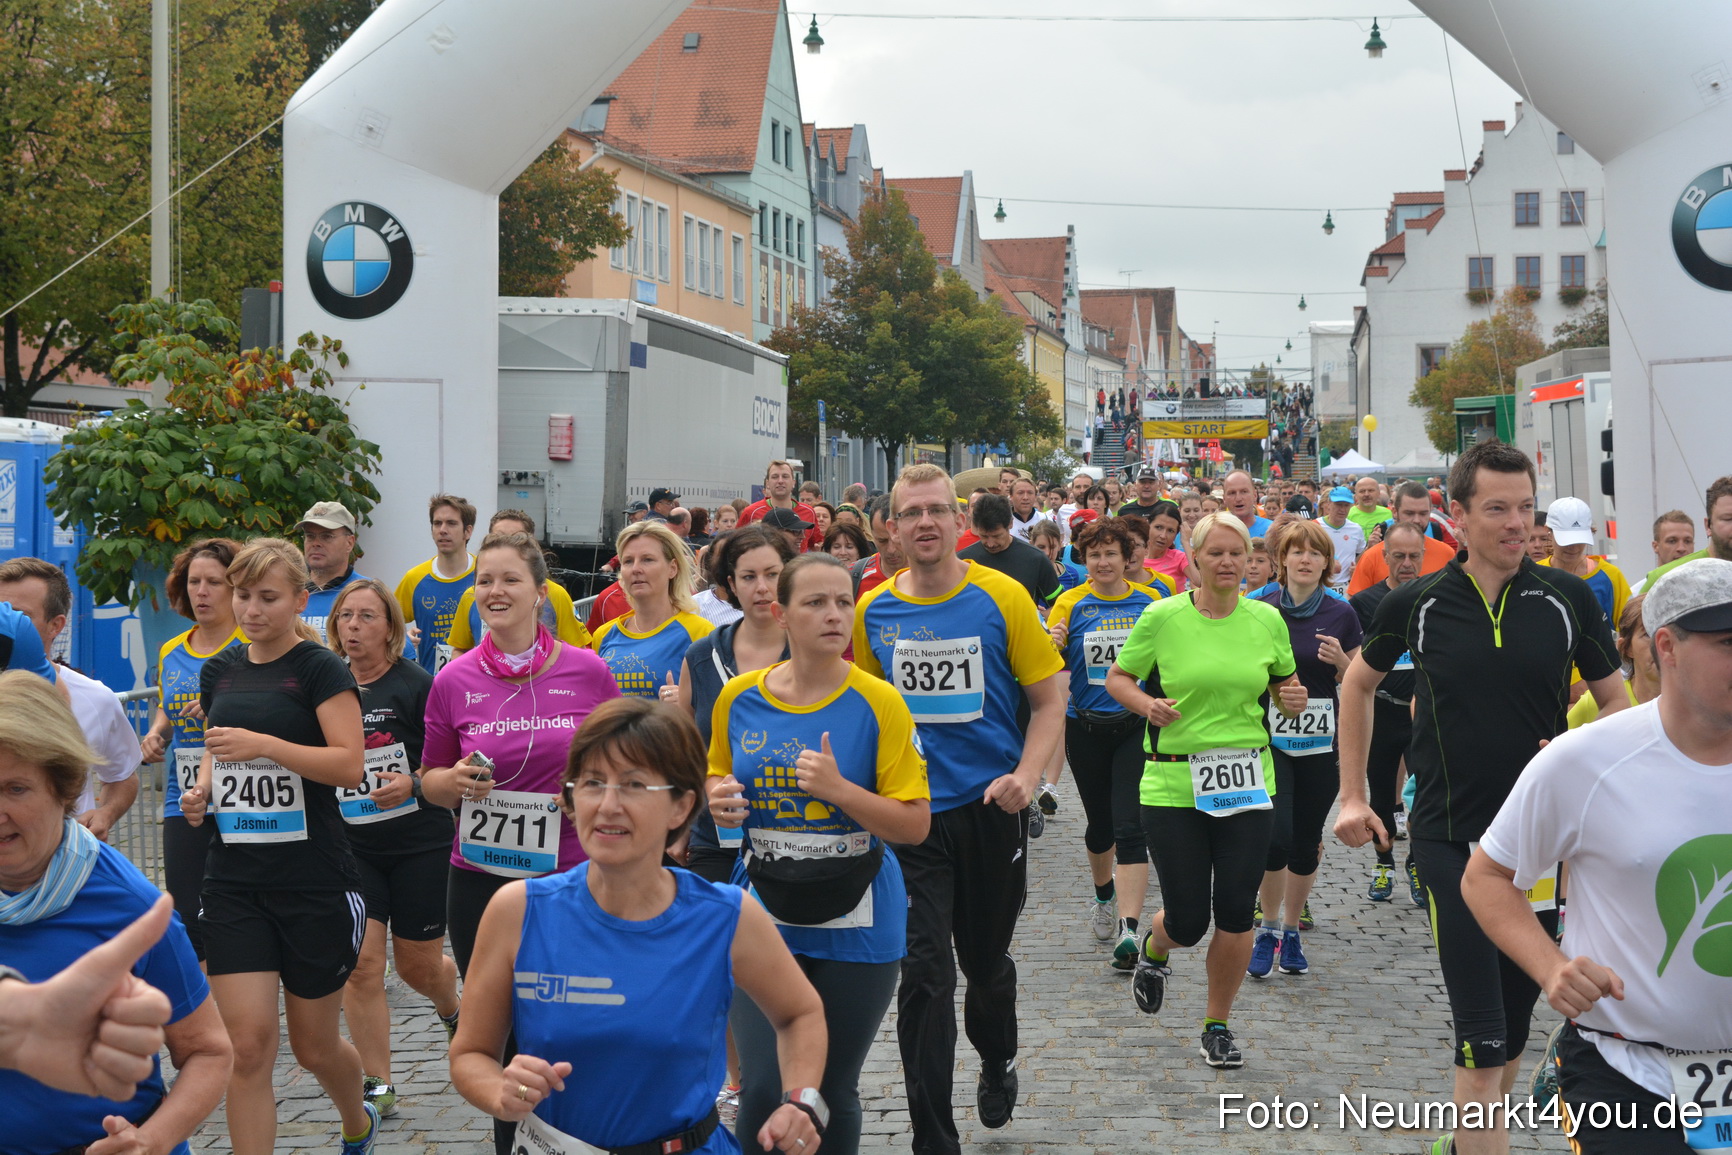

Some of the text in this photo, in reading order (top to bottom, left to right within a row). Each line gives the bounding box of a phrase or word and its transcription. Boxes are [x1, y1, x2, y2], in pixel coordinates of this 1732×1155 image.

[314, 204, 405, 243] BMW
[752, 396, 781, 439] BOCK
[1183, 424, 1227, 435] START
[895, 647, 965, 657] PARTL Neumarkt
[901, 659, 972, 692] 3321
[468, 715, 575, 736] Energiebündel
[1275, 713, 1329, 734] 2424
[1287, 740, 1314, 749] Teresa
[365, 754, 392, 764] umarkt
[1190, 752, 1249, 765] PARTL Neumarkt
[214, 762, 283, 771] PARTL Neumarkt
[1199, 761, 1256, 792] 2601
[220, 775, 295, 808] 2405
[496, 799, 543, 811] Neumarkt
[1213, 795, 1253, 808] Susanne
[234, 817, 278, 830] Jasmin
[470, 809, 547, 849] 2711
[752, 838, 833, 853] PARTL Neumarkt
[484, 850, 531, 868] Henrike
